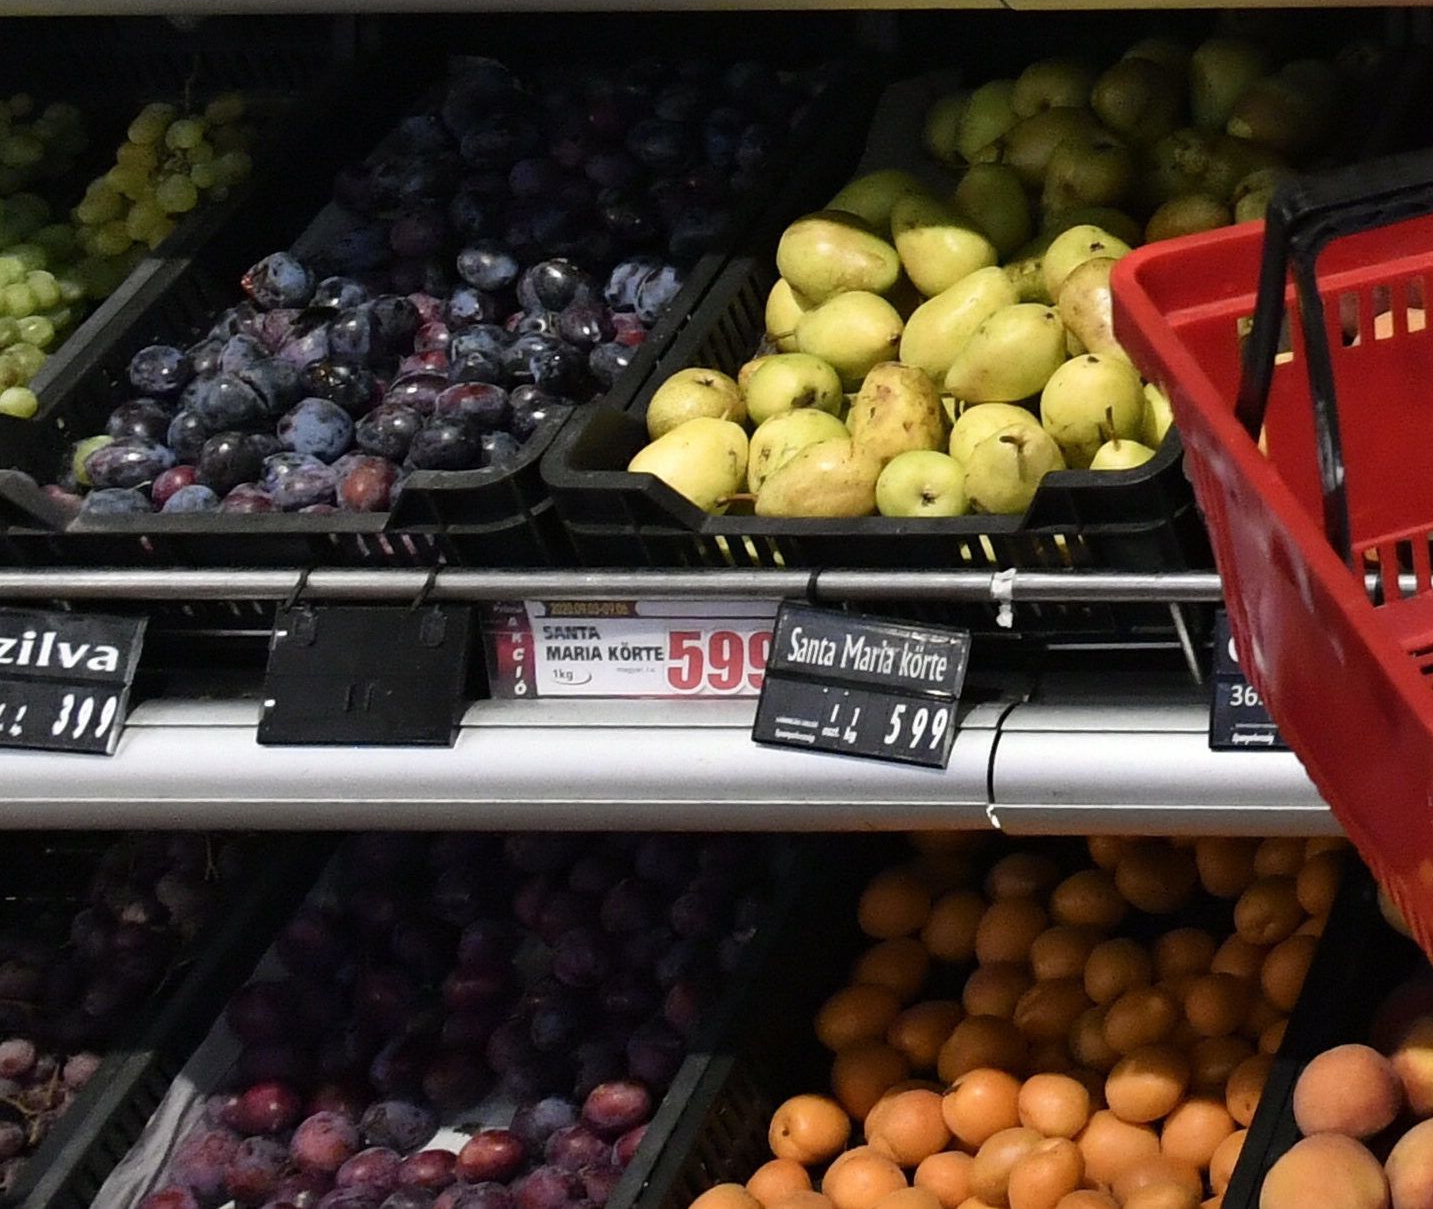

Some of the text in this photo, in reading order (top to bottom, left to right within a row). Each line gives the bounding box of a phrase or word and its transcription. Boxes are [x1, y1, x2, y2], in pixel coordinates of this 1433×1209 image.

[0, 630, 119, 672] zilva
[543, 626, 600, 640] SANTA
[546, 641, 664, 661] MARIA KÖRTE
[552, 668, 574, 681] 1kg
[668, 631, 774, 690] 599
[787, 627, 948, 682] Santa Maria körte
[52, 693, 118, 739] 399
[1229, 685, 1264, 706] 36
[883, 704, 949, 750] 599
